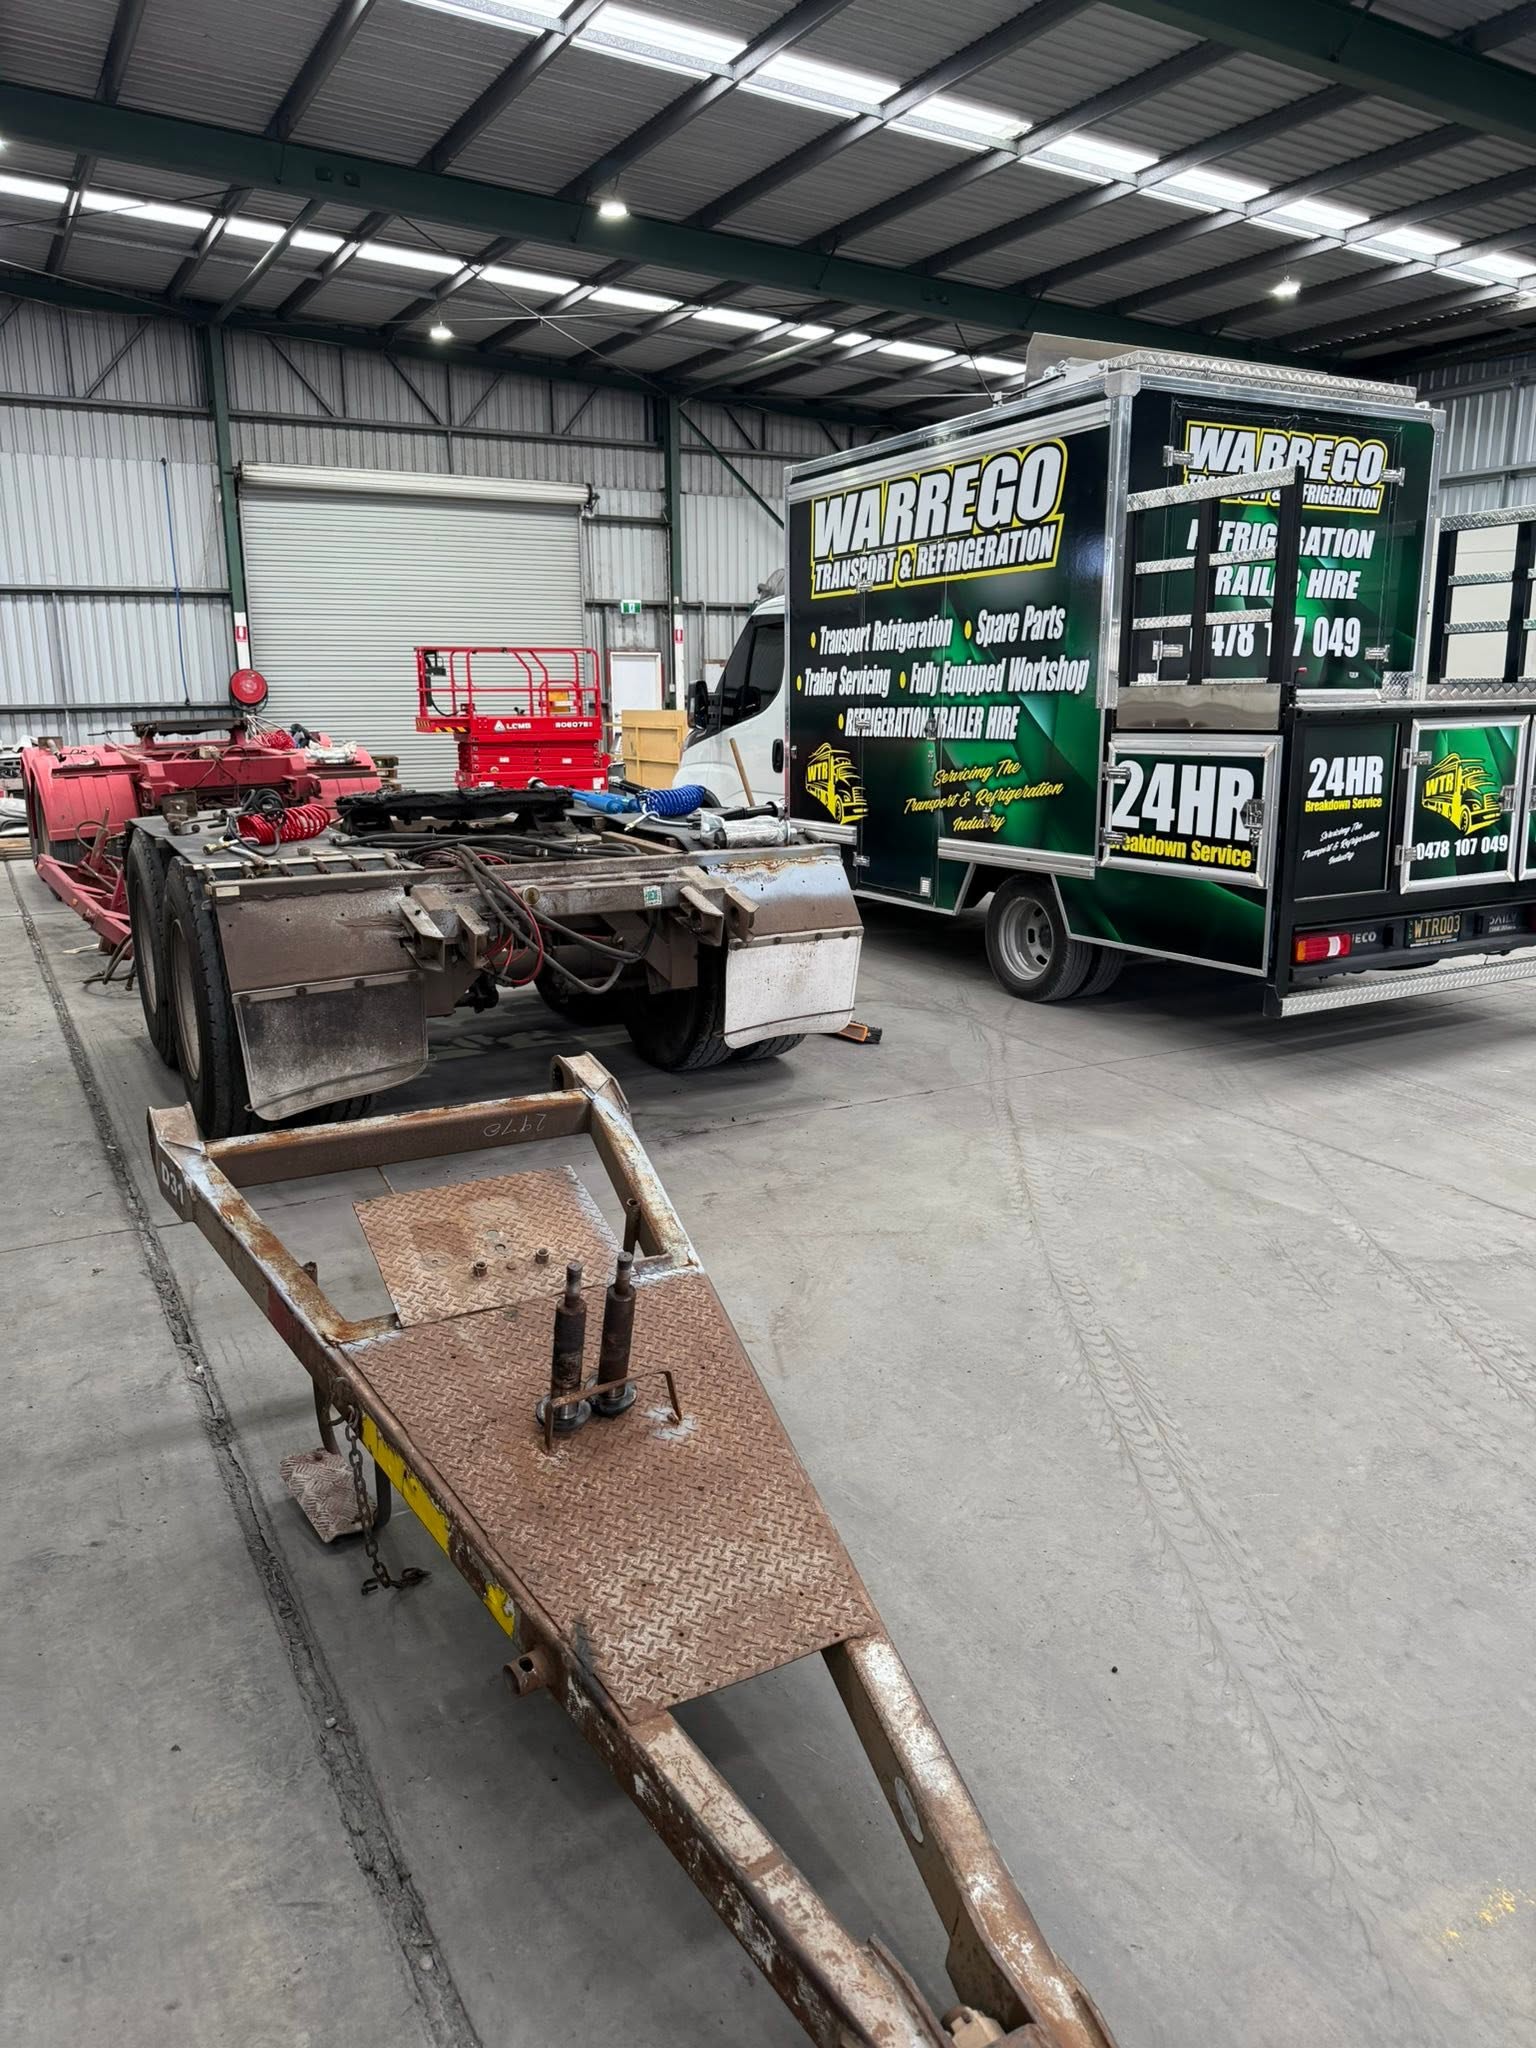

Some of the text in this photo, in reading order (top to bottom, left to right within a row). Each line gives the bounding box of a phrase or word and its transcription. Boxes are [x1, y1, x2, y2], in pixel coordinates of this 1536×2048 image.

[1188, 426, 1385, 486] WARREGO
[813, 446, 1062, 558] WARREGO
[1302, 485, 1380, 509] FRIGERATION
[814, 525, 1056, 591] TRANSPORT & REFRIGERATION
[1306, 569, 1361, 600] HIRE
[820, 615, 953, 656] Transport Refrigeration
[976, 605, 1066, 645] Spare Parts
[1264, 617, 1306, 657] 17
[1313, 616, 1361, 657] 049
[804, 665, 891, 698] Trailer Servicing
[909, 655, 1090, 696] Fully Equipped Workshop
[932, 706, 983, 739] TRAILER
[985, 706, 1020, 740] HIRE
[807, 761, 829, 783] WTR
[995, 759, 1021, 777] The
[1308, 755, 1384, 798] 24HR
[1425, 772, 1455, 797] WTR
[904, 782, 1065, 814] Transport & Refrigeration
[1112, 760, 1255, 841] 24HR
[1304, 797, 1383, 812] Breakdown Service
[1109, 834, 1251, 868] eakdown Service
[1416, 834, 1508, 860] 0478 107 049
[1352, 931, 1377, 944] ECO
[1414, 914, 1460, 939] WTR003
